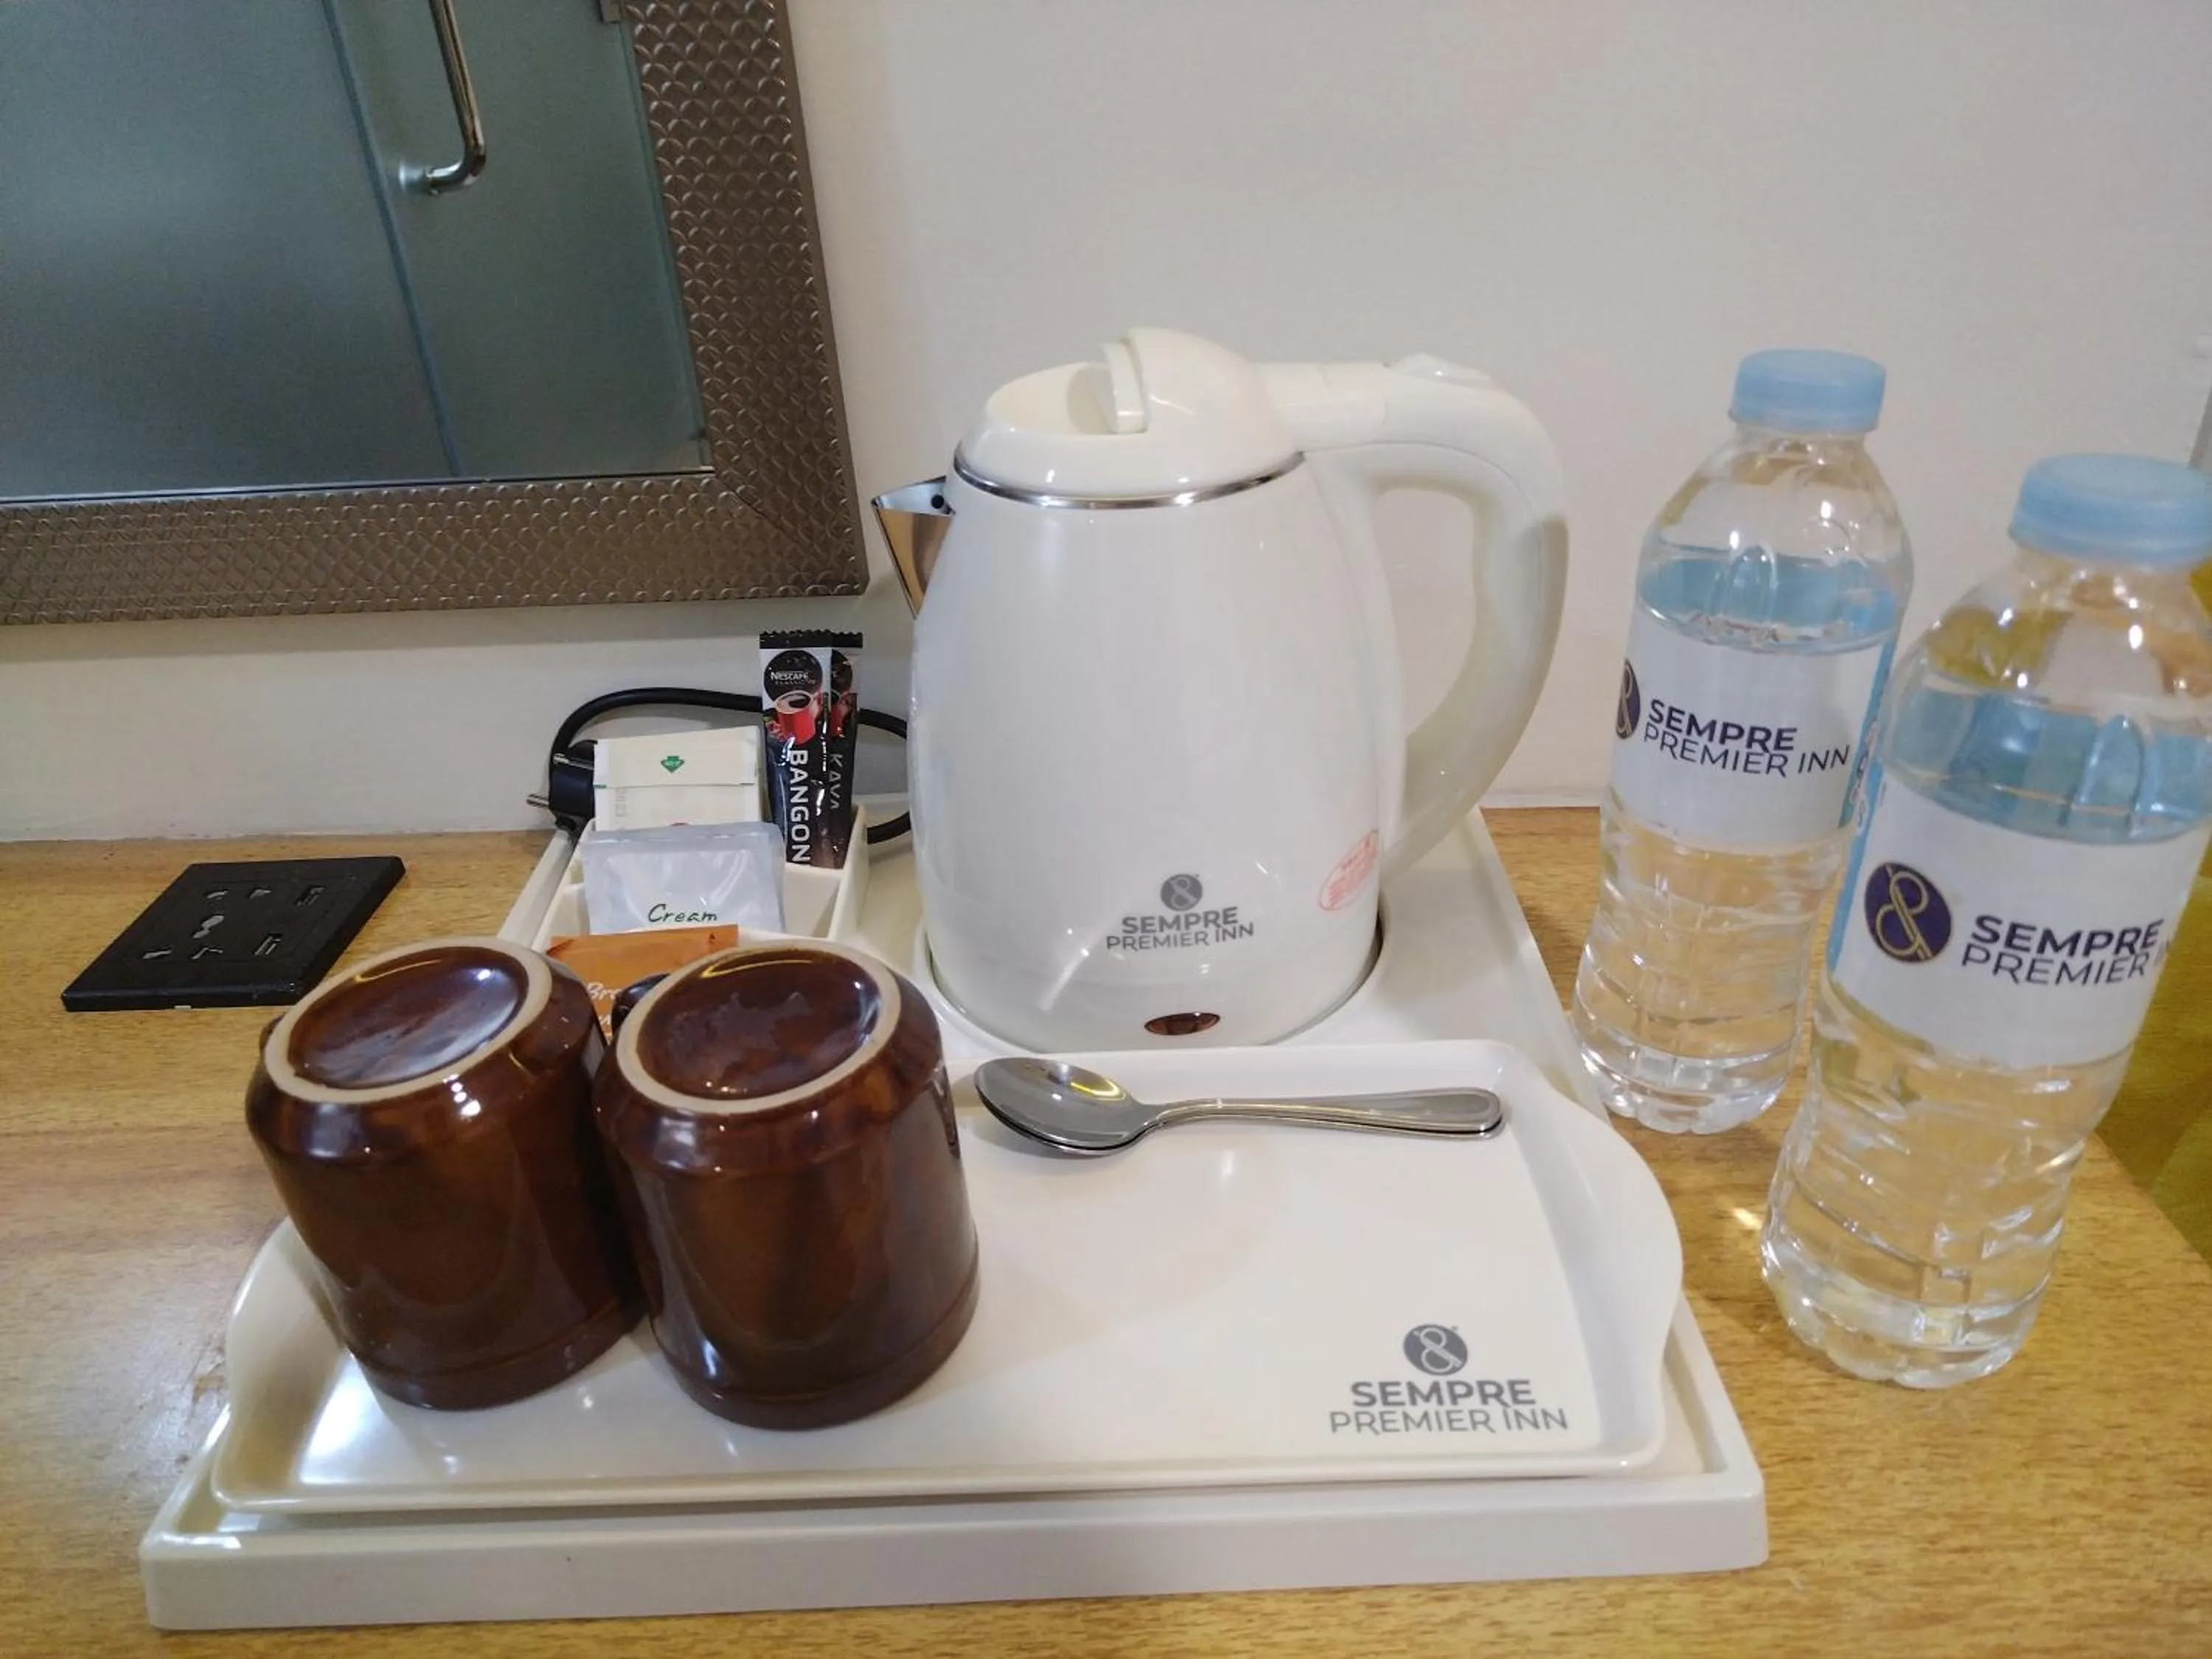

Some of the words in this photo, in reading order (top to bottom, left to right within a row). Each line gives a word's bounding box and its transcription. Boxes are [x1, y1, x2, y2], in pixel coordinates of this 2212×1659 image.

[1649, 698, 1798, 752] SEMPRE
[1644, 722, 1789, 777] PREMIER
[1798, 745, 1850, 774] INN
[790, 750, 811, 862] BANGON
[648, 904, 718, 922] Cream
[1121, 906, 1239, 935] SEMPRE
[1107, 931, 1209, 952] PREMIER
[1215, 922, 1254, 944] INN
[1971, 914, 2164, 958] SEMPRE
[1961, 942, 2150, 987] PREMIER
[1351, 1380, 1536, 1408] SEMPRE
[1330, 1409, 1497, 1436] PREMIER
[1505, 1408, 1569, 1431] INN
